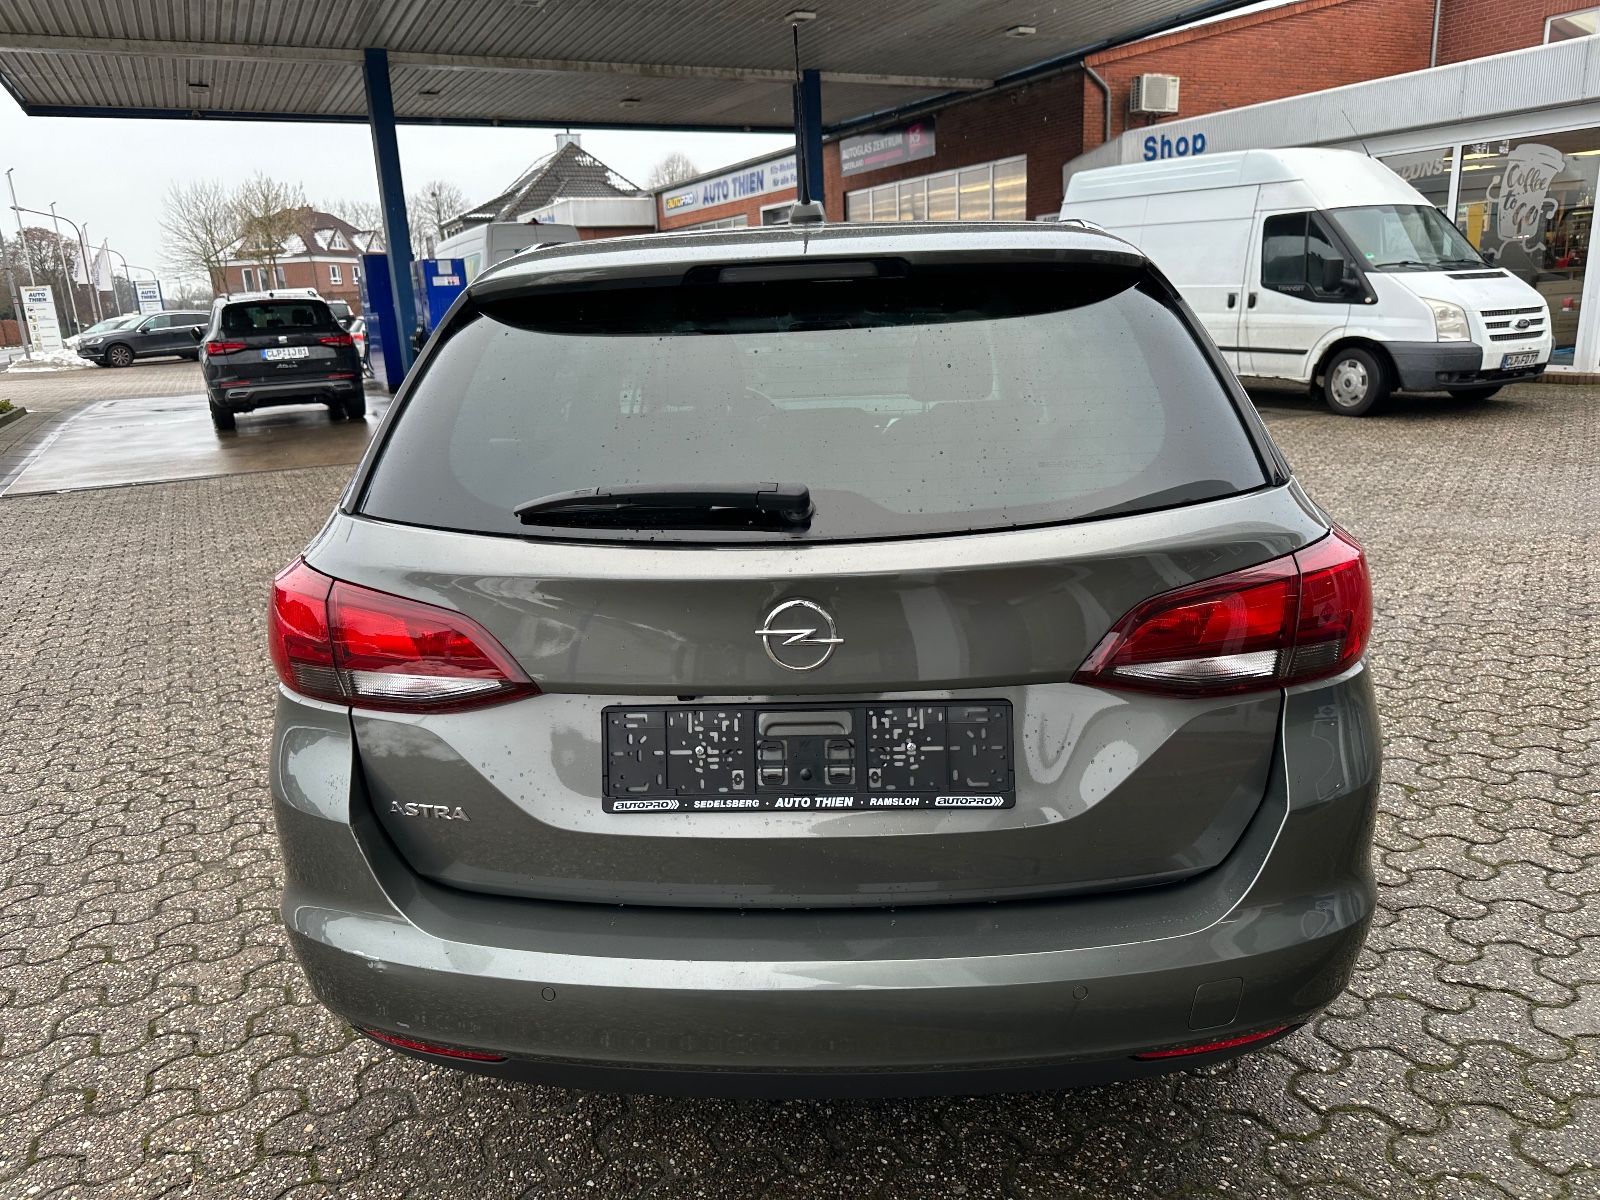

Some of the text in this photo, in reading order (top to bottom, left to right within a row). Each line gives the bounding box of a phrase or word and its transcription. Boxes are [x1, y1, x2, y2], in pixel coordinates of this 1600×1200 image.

[1143, 133, 1206, 162] Shop
[703, 180, 729, 205] AUTO
[732, 169, 765, 198] THIEN
[1507, 163, 1547, 194] Coffee
[1501, 190, 1516, 210] to
[389, 800, 471, 821] ASTRA
[693, 799, 760, 808] SEDELSBERG
[775, 797, 811, 808] AUTO
[814, 796, 853, 807] THIEN
[869, 797, 920, 806] RAMSLOH
